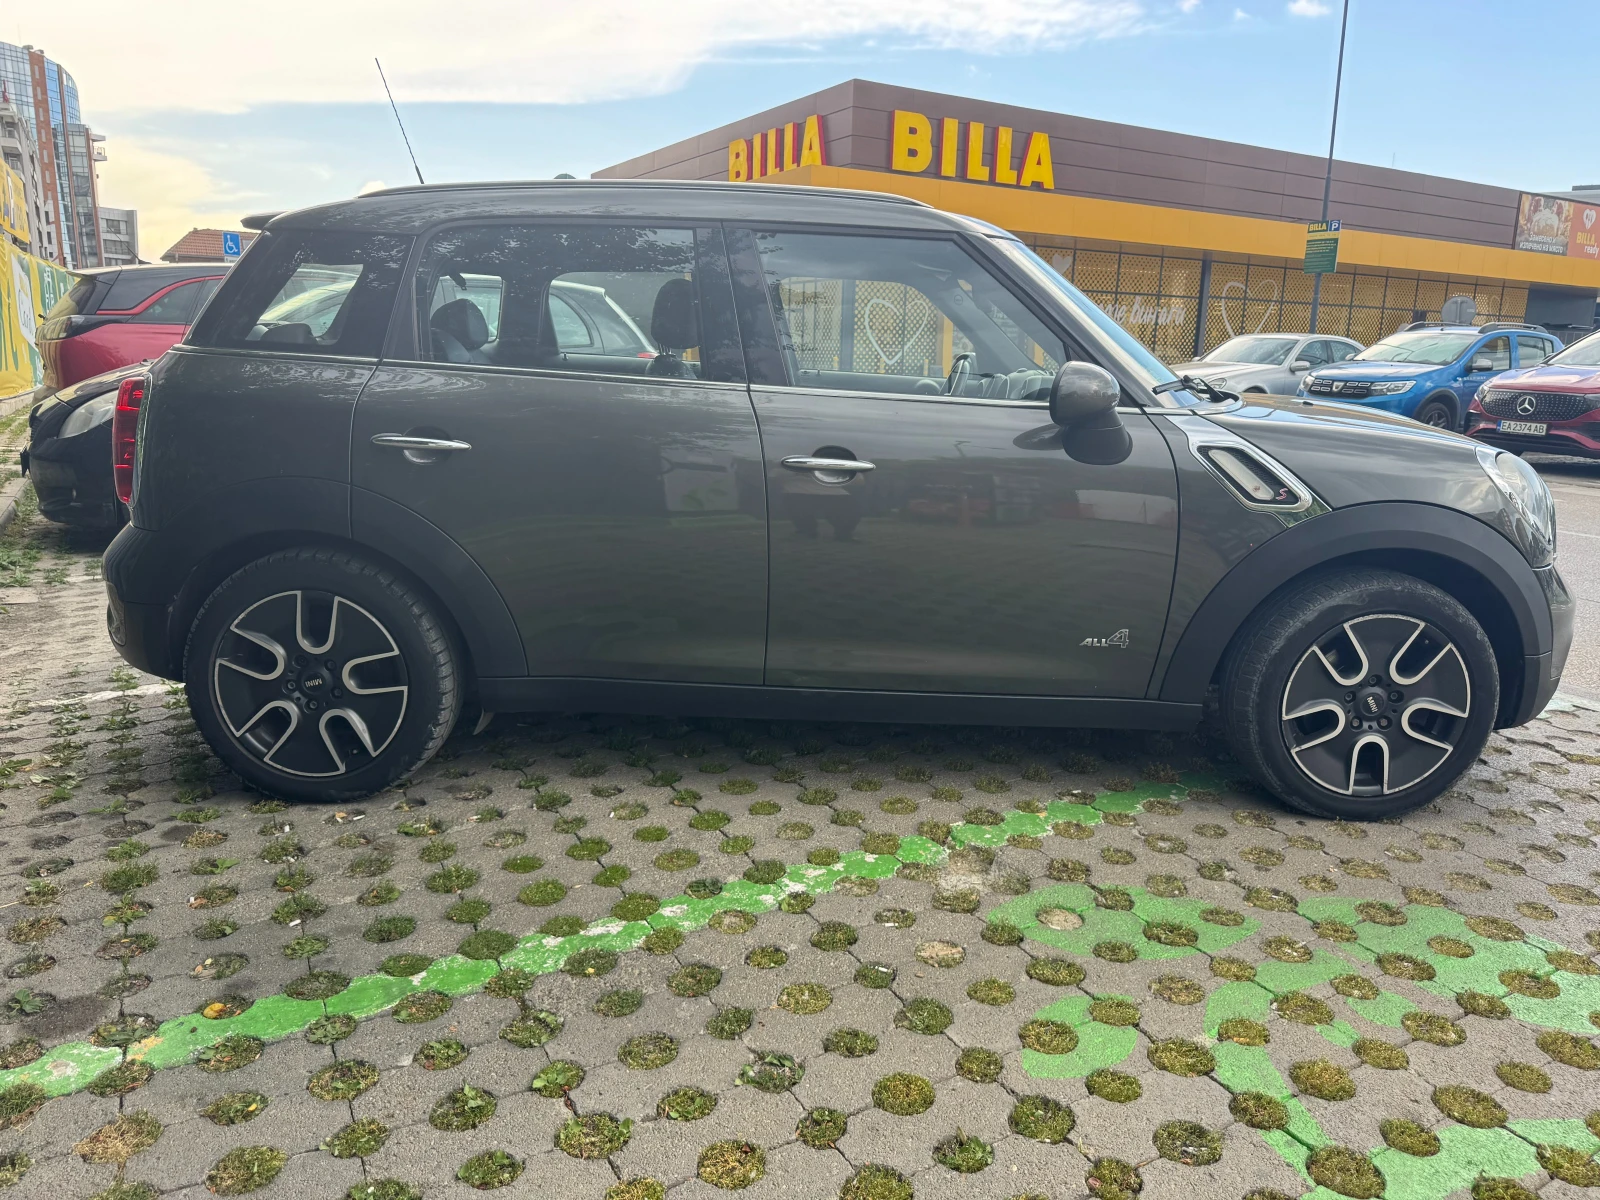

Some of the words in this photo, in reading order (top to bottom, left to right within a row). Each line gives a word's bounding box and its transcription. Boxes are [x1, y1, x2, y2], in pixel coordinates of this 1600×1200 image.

[728, 114, 827, 182] BILLA
[890, 109, 1055, 190] BILLA
[1309, 223, 1327, 231] BILLA
[1576, 232, 1595, 245] BILLA
[1584, 243, 1600, 258] ready
[1512, 423, 1532, 432] 2374
[304, 678, 323, 688] MINI
[1366, 696, 1379, 713] MINI
